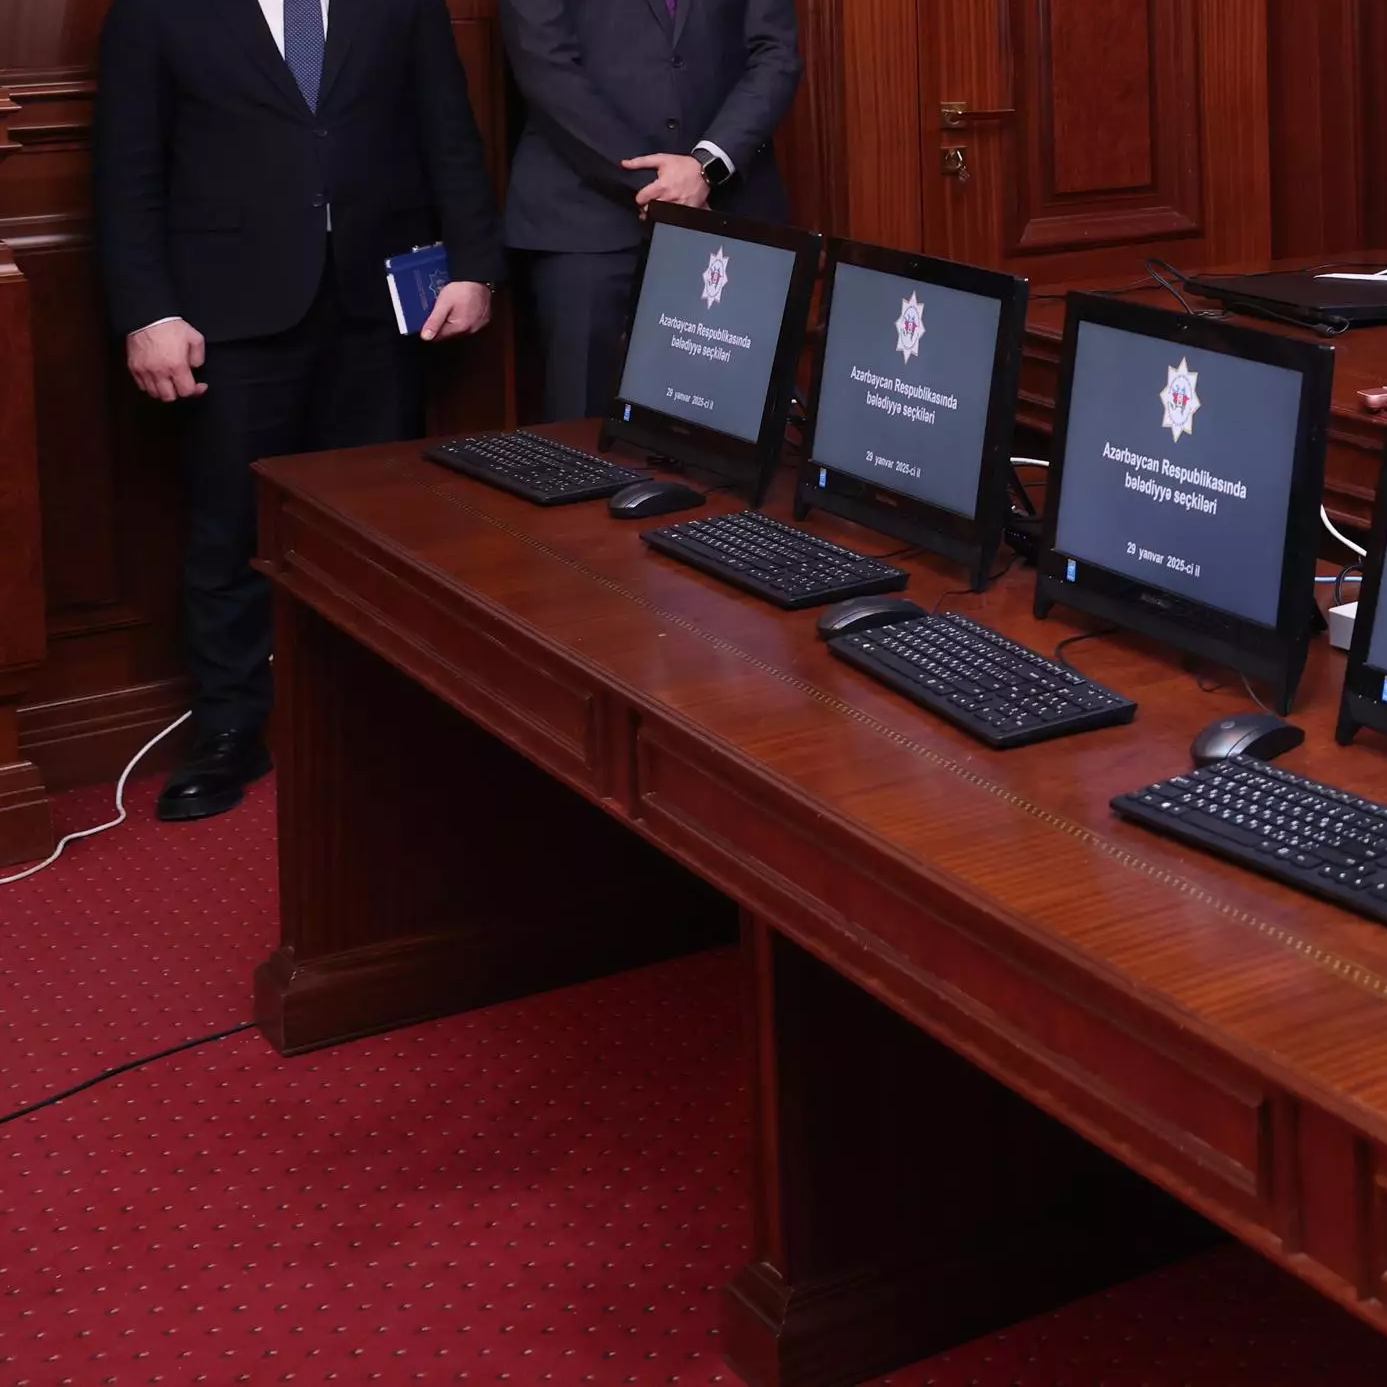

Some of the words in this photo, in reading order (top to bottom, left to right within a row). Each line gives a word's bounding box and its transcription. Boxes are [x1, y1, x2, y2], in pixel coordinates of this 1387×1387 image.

[1103, 443, 1159, 473] Azərbaycan
[1162, 459, 1247, 499] Respublikasında
[1125, 473, 1172, 502] bələdiyyə
[1174, 488, 1217, 514] seçkiləri
[1126, 542, 1136, 554] 29
[1138, 546, 1164, 565] yanvar
[1167, 555, 1193, 575] 2025-ci
